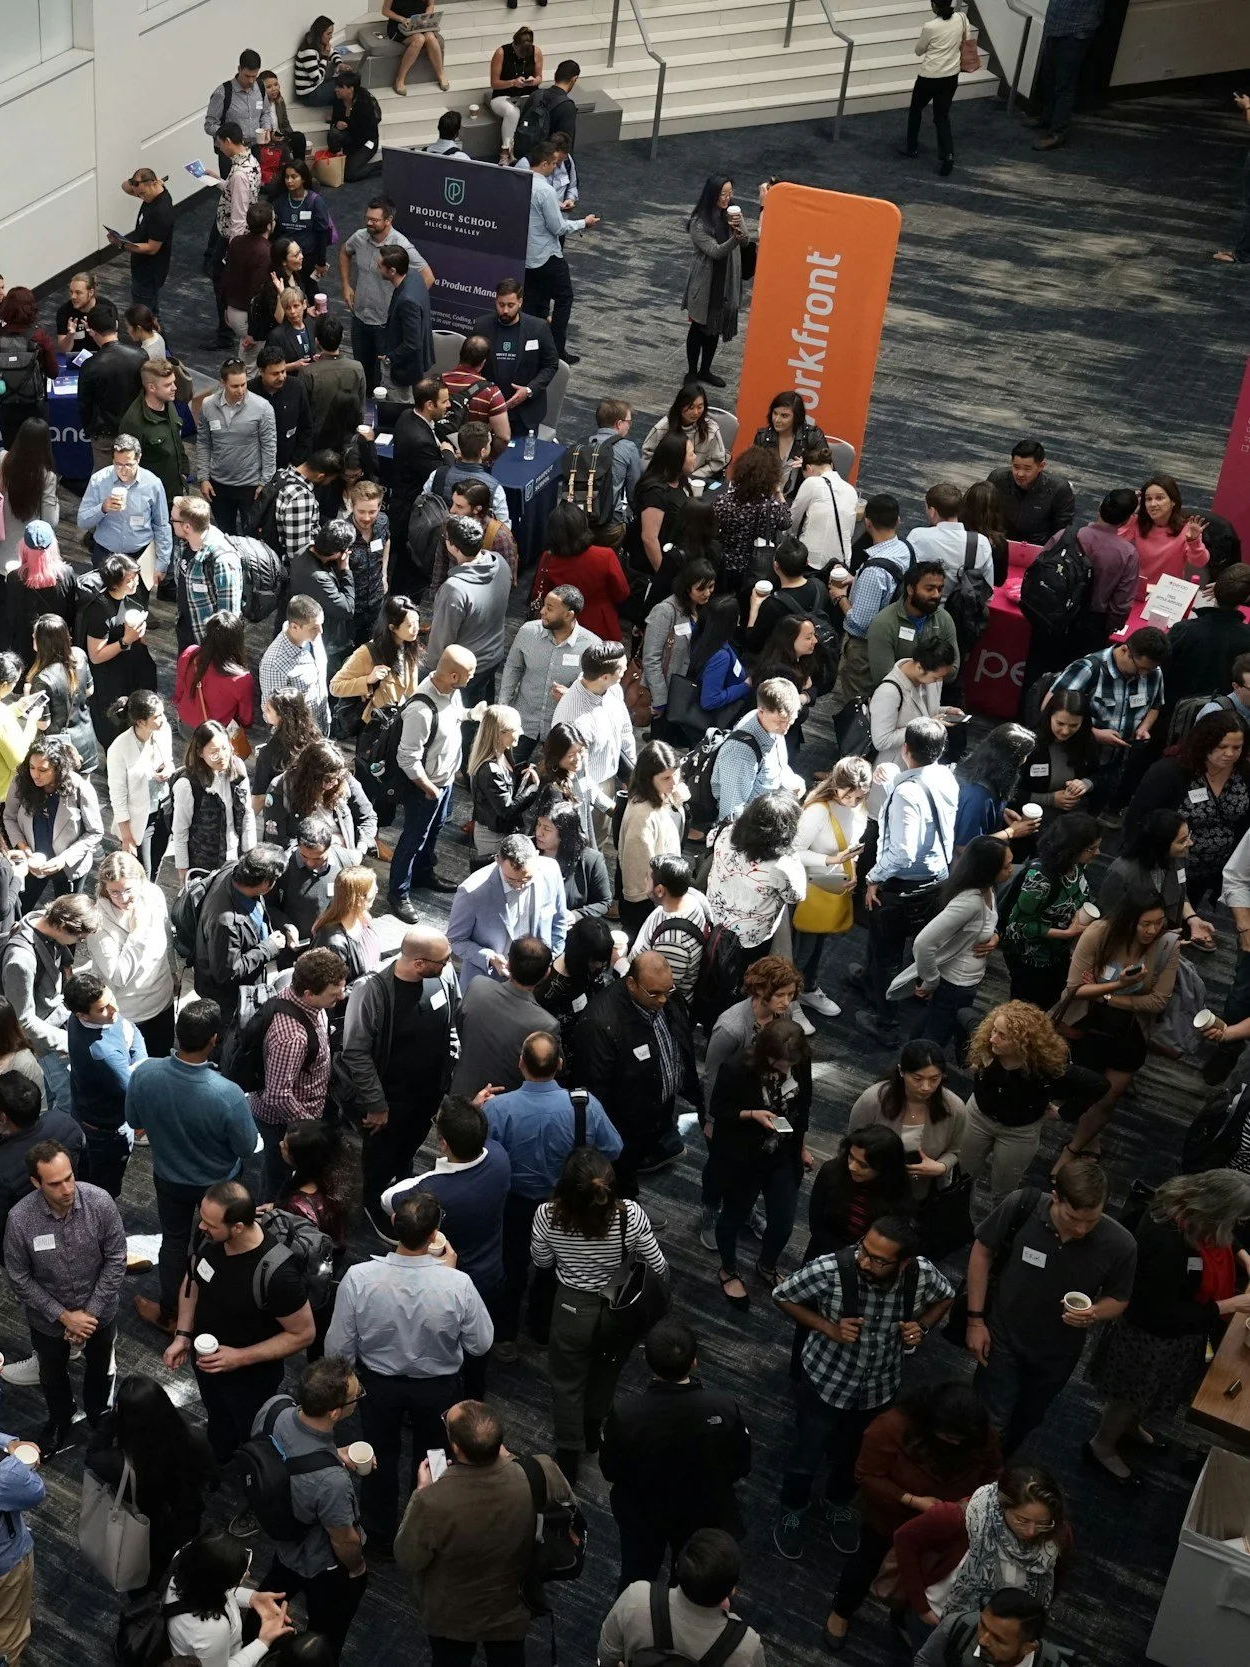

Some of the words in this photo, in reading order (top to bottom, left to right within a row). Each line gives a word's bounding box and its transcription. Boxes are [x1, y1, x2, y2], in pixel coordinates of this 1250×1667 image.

[409, 205, 455, 221] PRODUCT
[458, 215, 498, 229] SCHOOL
[424, 221, 452, 230] SILICON
[454, 227, 480, 236] VALLEY
[441, 279, 472, 293] Product
[472, 286, 497, 298] Mana
[787, 250, 842, 426] orkfront
